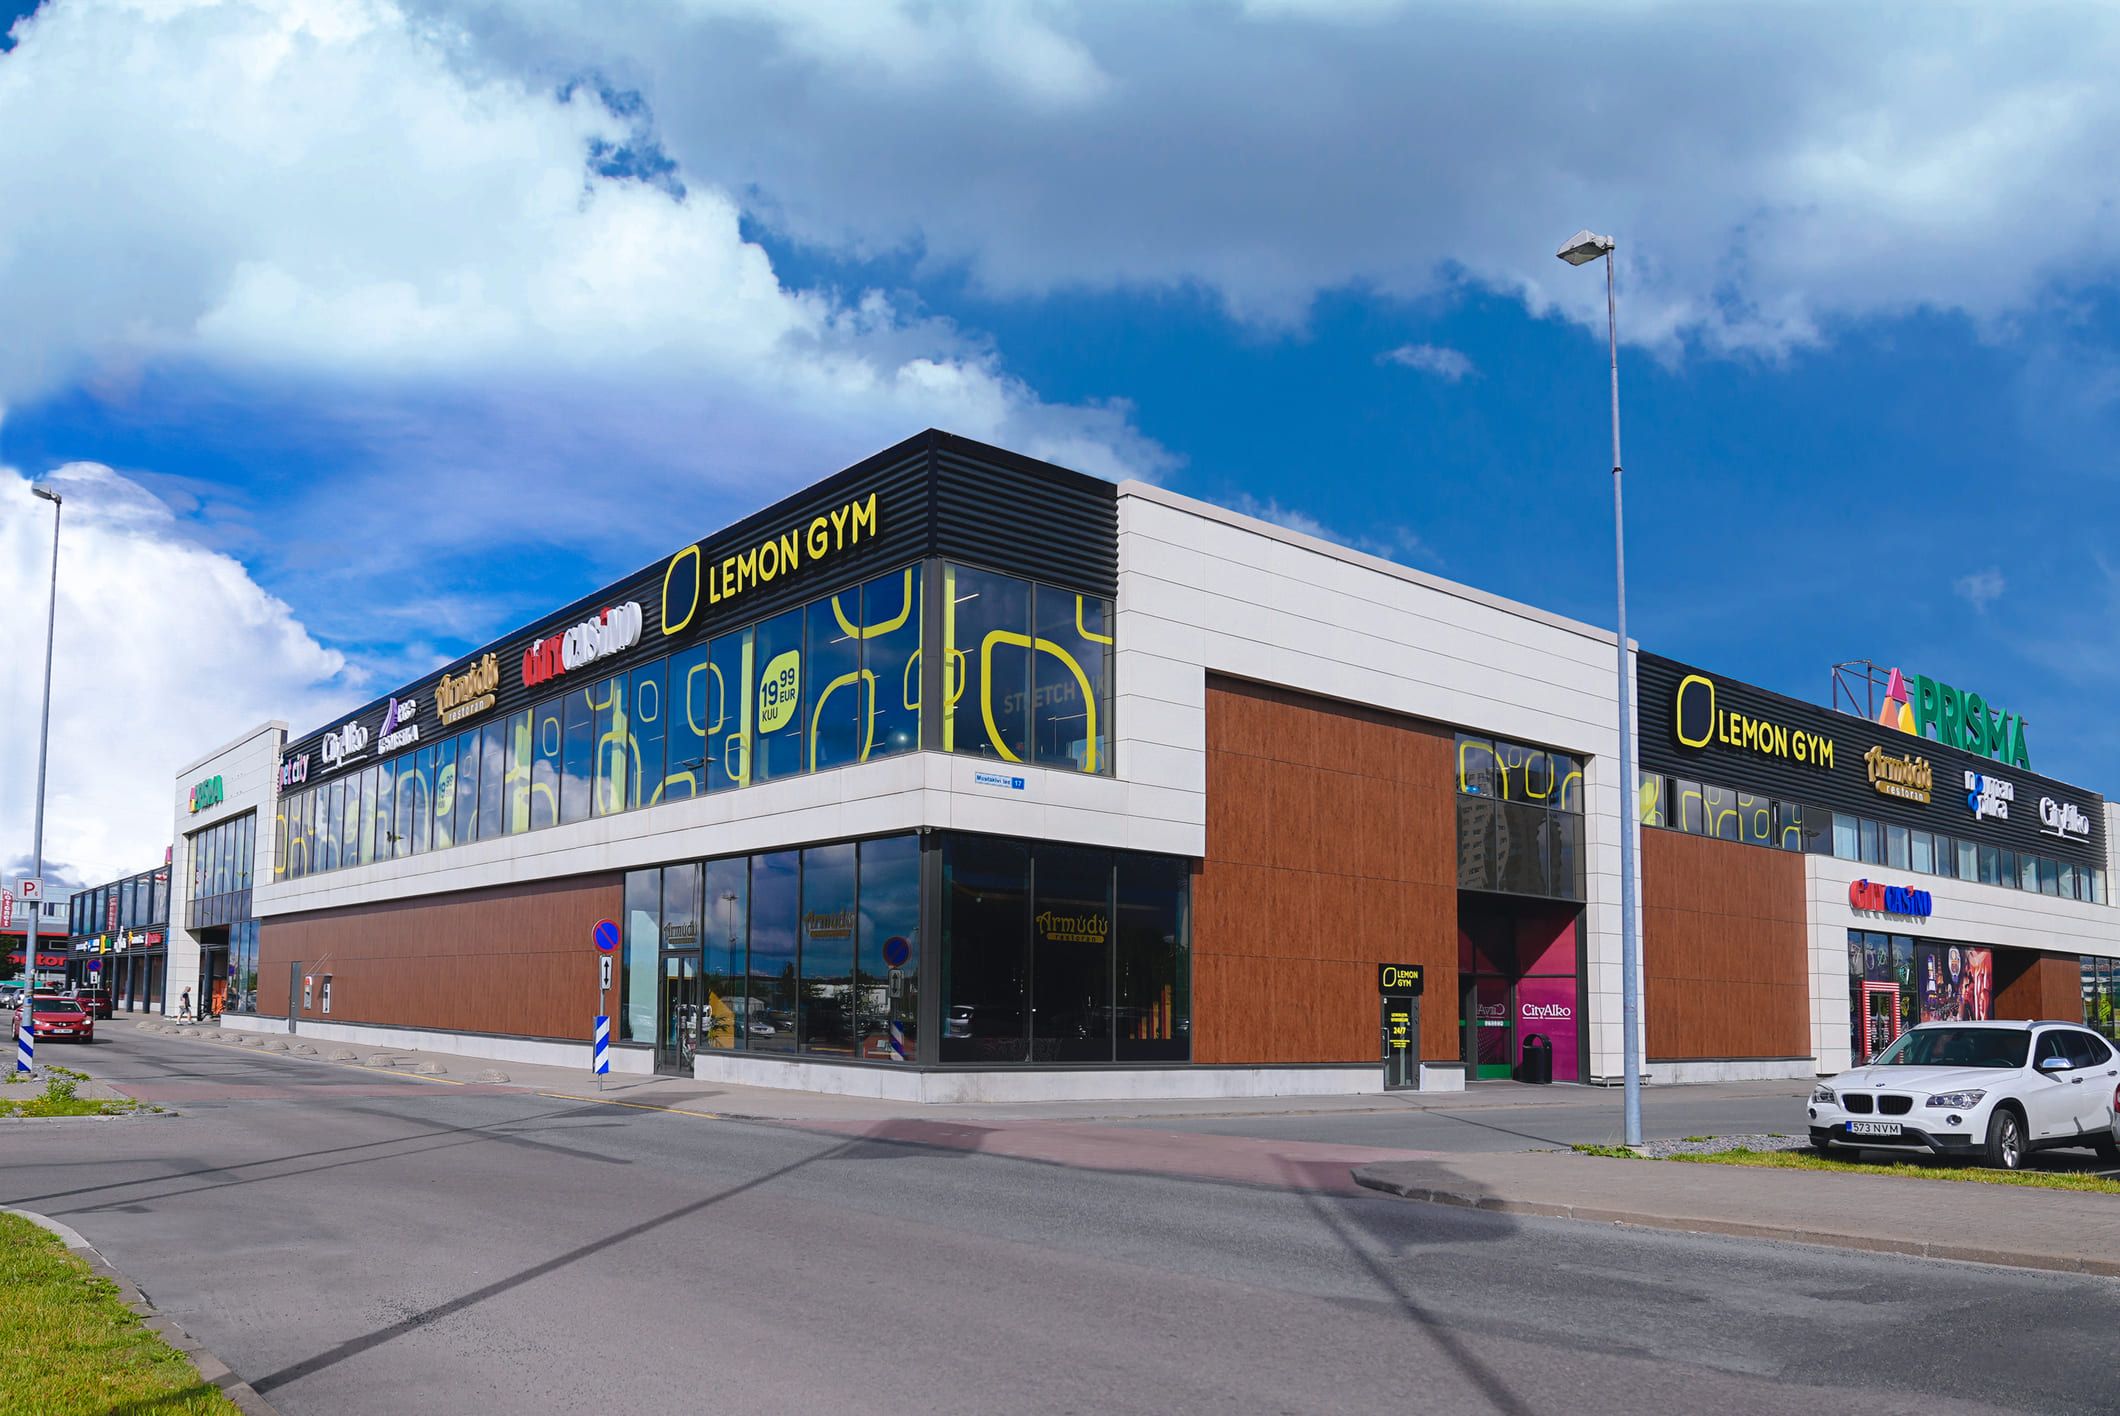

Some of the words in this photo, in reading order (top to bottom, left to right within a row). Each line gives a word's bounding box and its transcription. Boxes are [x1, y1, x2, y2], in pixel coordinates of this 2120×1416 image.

[709, 528, 799, 605] LEMON
[806, 492, 876, 560] GYM
[780, 667, 795, 688] 99
[761, 680, 779, 708] 19
[779, 688, 796, 703] EUR
[1003, 681, 1076, 714] STETCH
[447, 699, 485, 722] restoran
[761, 707, 779, 722] KUU
[1913, 673, 2032, 771] PRISMA
[1718, 709, 1788, 758] LEMON
[1792, 730, 1834, 769] GYM
[24, 881, 35, 896] P
[1397, 970, 1419, 979] LEMON
[1397, 979, 1412, 987] GYM
[1522, 1003, 1571, 1018] CityAlko
[1393, 1026, 1407, 1034] 24/7
[1853, 1123, 1871, 1132] 573
[1873, 1124, 1899, 1133] NVM
